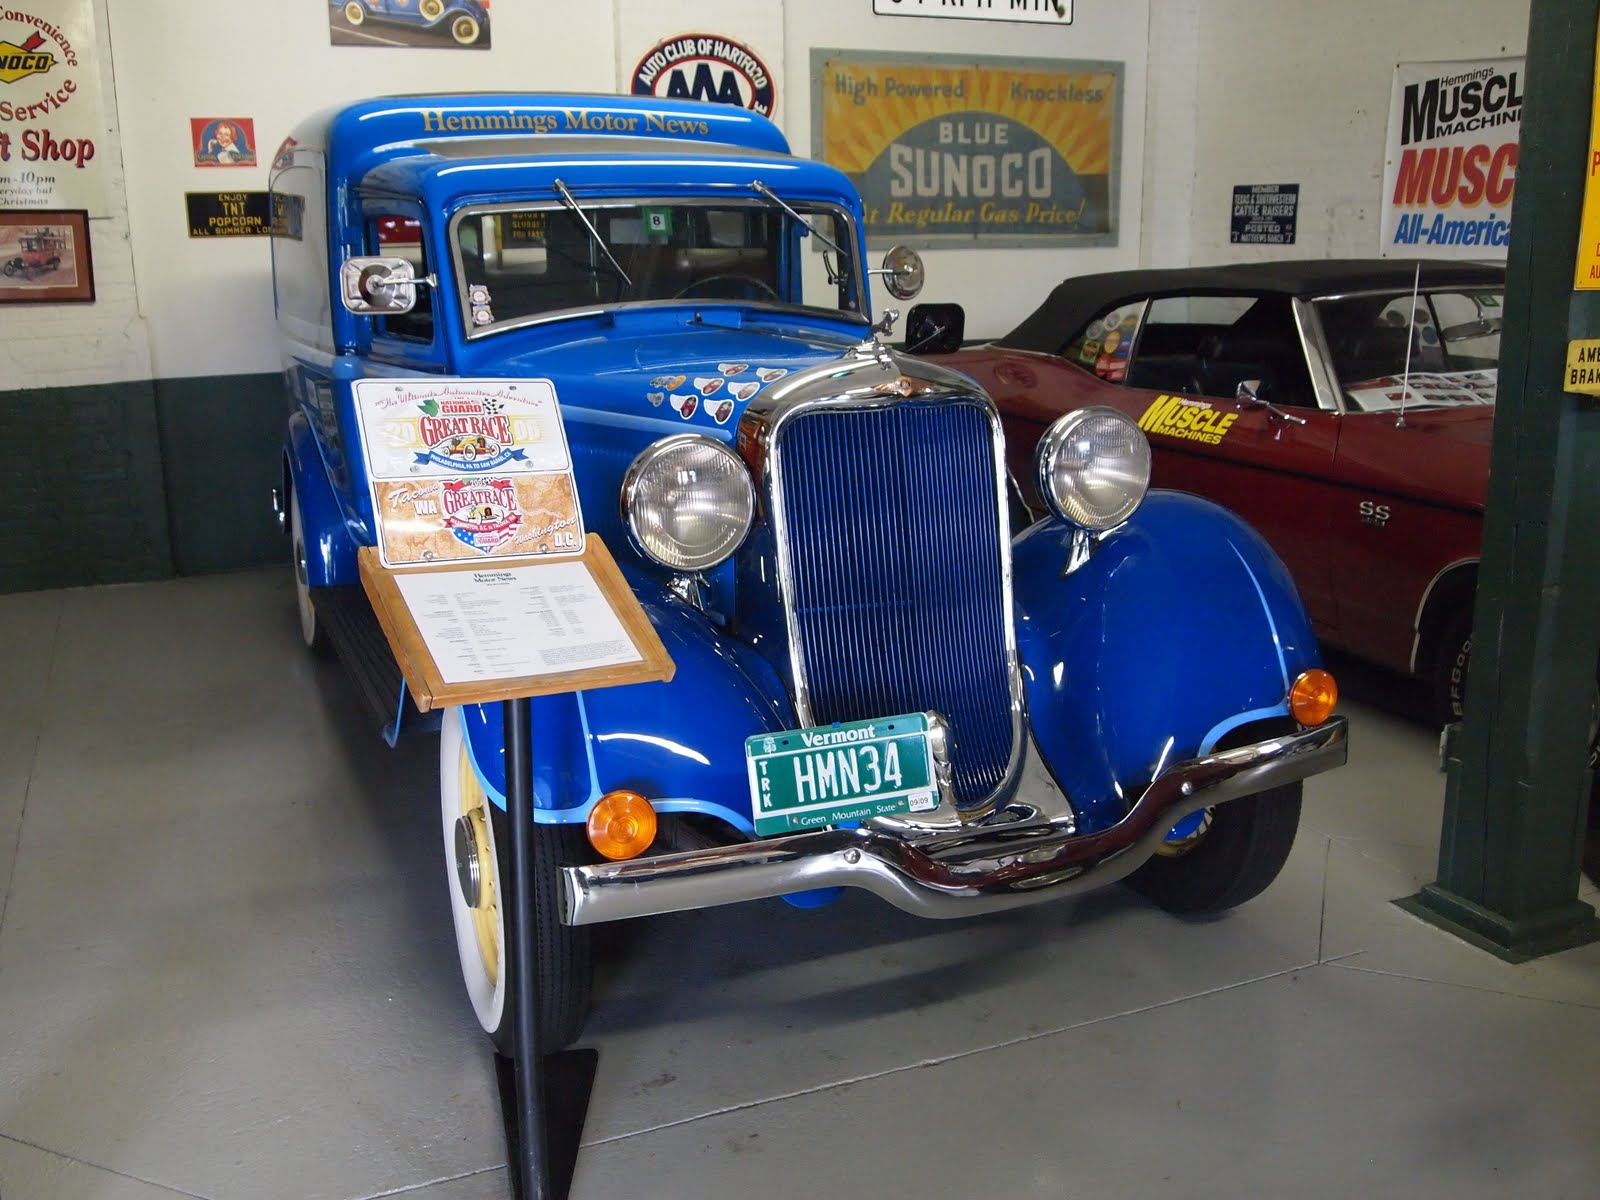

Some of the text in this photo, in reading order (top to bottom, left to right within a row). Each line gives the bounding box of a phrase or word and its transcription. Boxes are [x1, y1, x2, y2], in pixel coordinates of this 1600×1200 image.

[639, 38, 768, 89] AUTO CLUB OF HARTFORD
[666, 62, 745, 107] AAA
[835, 73, 1104, 105] High Powered Knockless
[1440, 67, 1494, 88] Hemmings
[0, 79, 77, 121] Service
[419, 109, 709, 135] Hemmings Motor News
[939, 121, 1009, 144] BLUE
[21, 128, 95, 168] Shop
[890, 144, 1052, 198] SUNOCO
[1392, 143, 1520, 208] MUSC
[219, 193, 248, 201] ENJOY
[223, 202, 246, 215] TNT
[209, 216, 262, 226] POPCORN
[888, 202, 975, 228] Regular
[979, 202, 1020, 224] Gas
[1025, 198, 1087, 230] Price!
[1235, 204, 1260, 216] CATTLE
[441, 404, 482, 413] GUARD
[1137, 394, 1239, 434] MUSCLE
[420, 415, 511, 446] GREAT RACE
[1155, 425, 1222, 444] MACHINES
[413, 500, 438, 515] WA
[1360, 501, 1390, 520] SS
[554, 532, 577, 547] D.C.
[801, 725, 876, 748] Vermont
[759, 761, 772, 808] TRK
[793, 742, 902, 803] HMN34
[801, 804, 896, 826] Green Mountain State
